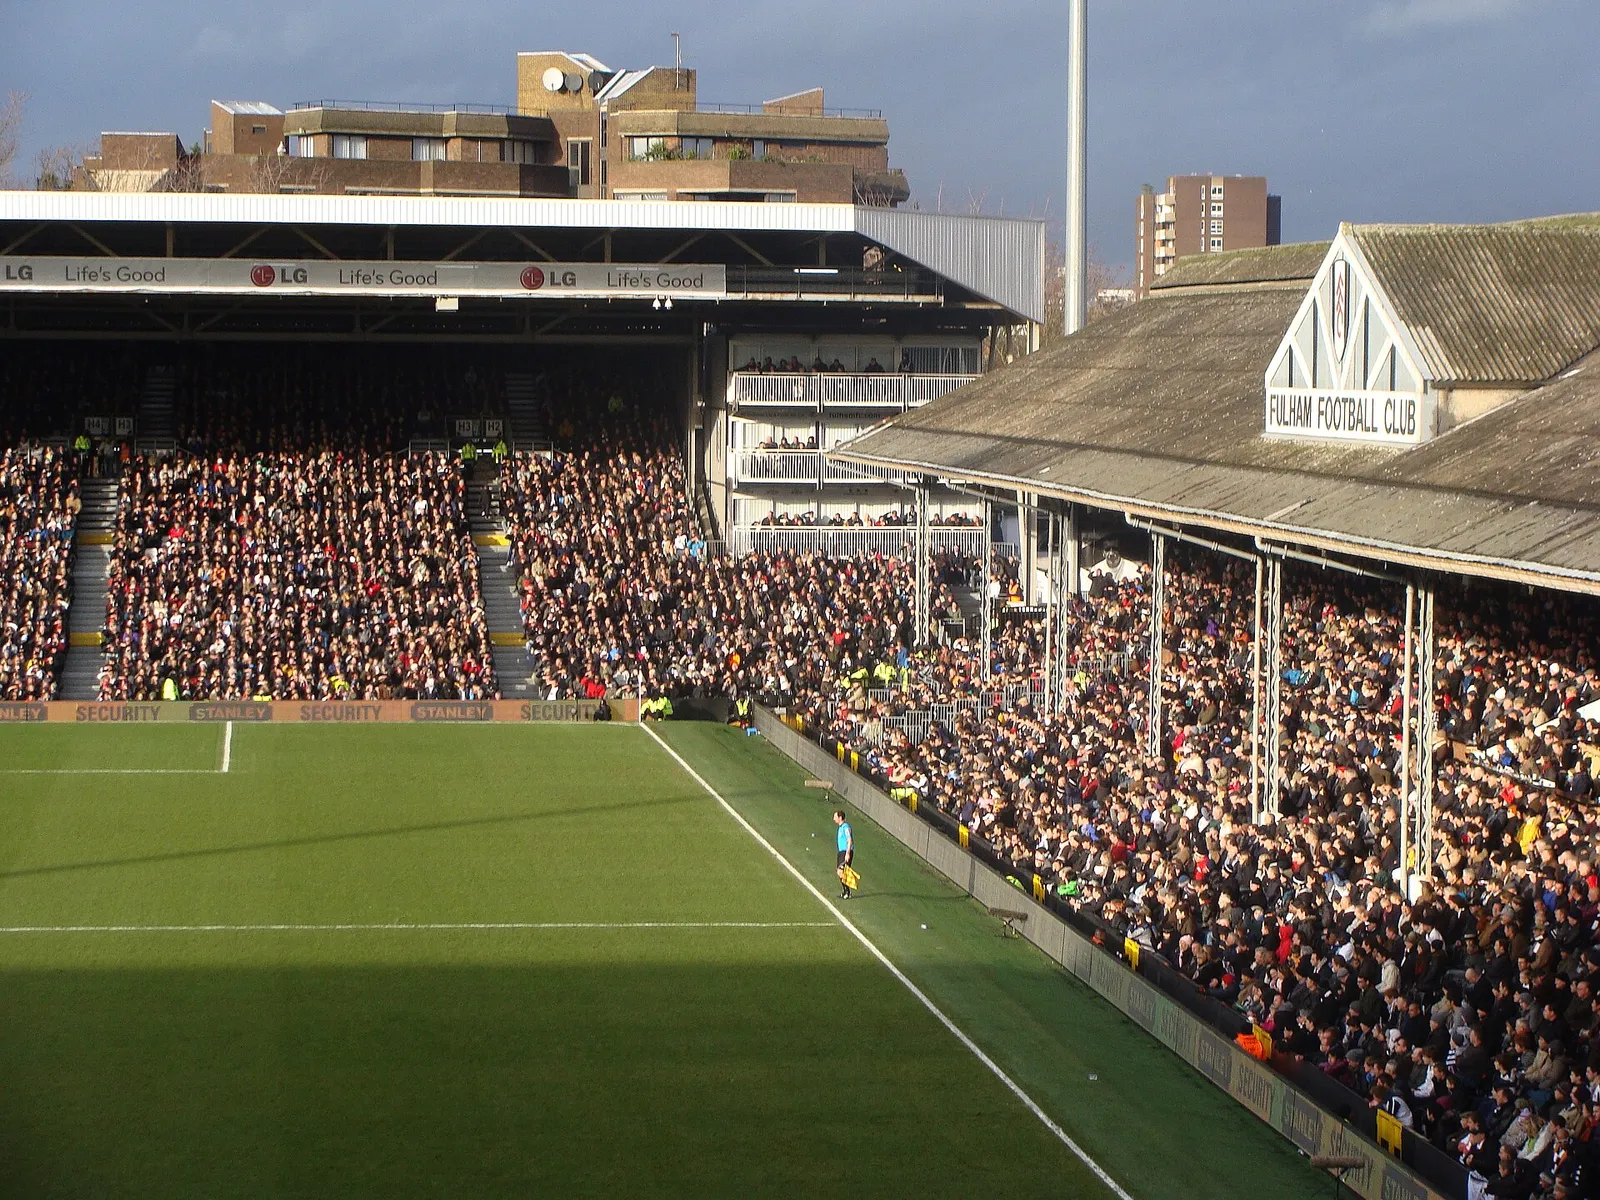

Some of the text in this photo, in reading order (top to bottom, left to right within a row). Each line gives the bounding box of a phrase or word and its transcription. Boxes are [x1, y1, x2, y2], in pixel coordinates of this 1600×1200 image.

[6, 265, 33, 281] LG
[65, 266, 166, 283] Life's Good
[281, 268, 308, 284] LG
[340, 269, 438, 286] Life's Good
[550, 272, 577, 287] LG
[607, 272, 704, 289] Life's Good
[1270, 394, 1416, 435] FULHAM FOOTBALL CLUB
[458, 421, 471, 432] H3
[488, 421, 501, 432] H2
[76, 704, 161, 722] SECURITY
[196, 706, 266, 720] STANLEY
[300, 704, 382, 722] SECURITY
[416, 706, 487, 720] STANLEY
[1237, 1062, 1273, 1116] SECURITY
